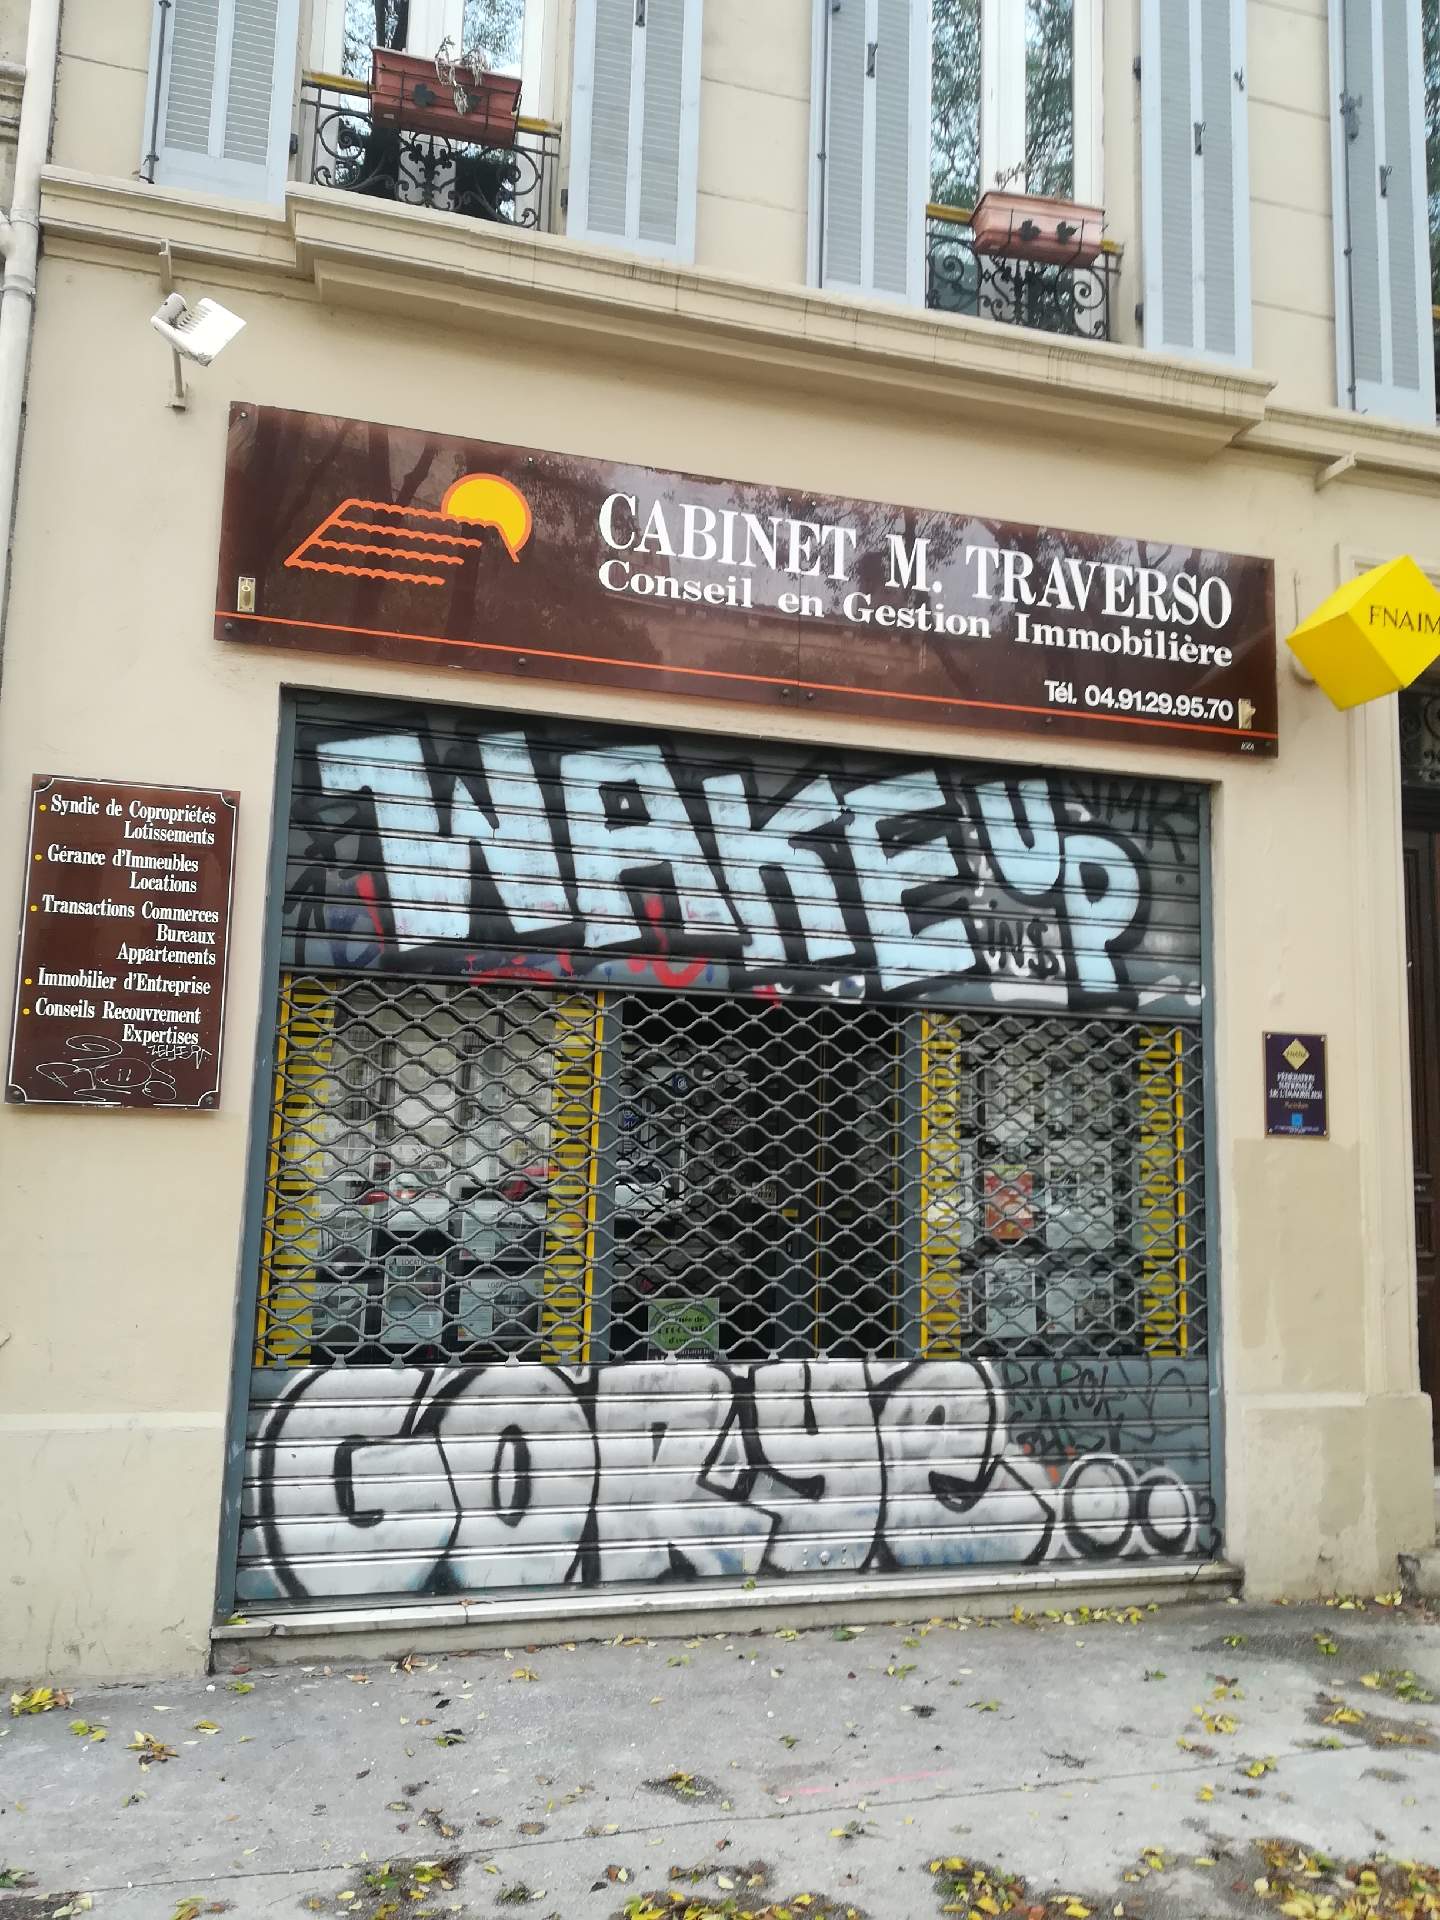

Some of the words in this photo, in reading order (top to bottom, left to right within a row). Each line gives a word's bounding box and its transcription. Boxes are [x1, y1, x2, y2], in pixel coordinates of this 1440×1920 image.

[598, 493, 857, 581] CABINET
[885, 534, 943, 592] M.
[966, 545, 1232, 630] TRAVERSO
[598, 560, 753, 609] Conseil
[777, 592, 824, 618] en
[843, 591, 991, 639] Gestion
[1014, 613, 1232, 668] Immobilière
[1369, 604, 1440, 635] FNAIM
[1044, 681, 1077, 705] Tél.
[1084, 688, 1233, 722] 04.91.29.95.70
[51, 794, 100, 815] Syndic
[106, 798, 122, 816] de
[129, 800, 216, 824] Copropriétés
[124, 821, 215, 845] Lotissements
[47, 843, 106, 865] Gérance
[112, 849, 199, 872] d'Immeubles
[129, 871, 197, 893] Locations
[42, 894, 135, 918] Transactions
[141, 901, 219, 923] Commerces
[156, 923, 215, 945] Bureaux
[116, 942, 216, 965] Appartements
[38, 967, 117, 990] Immobilier
[123, 972, 211, 997] d'Entreprise
[35, 997, 95, 1018] Conseils
[102, 1000, 201, 1024] Recouvrement
[122, 1024, 199, 1047] Expertises
